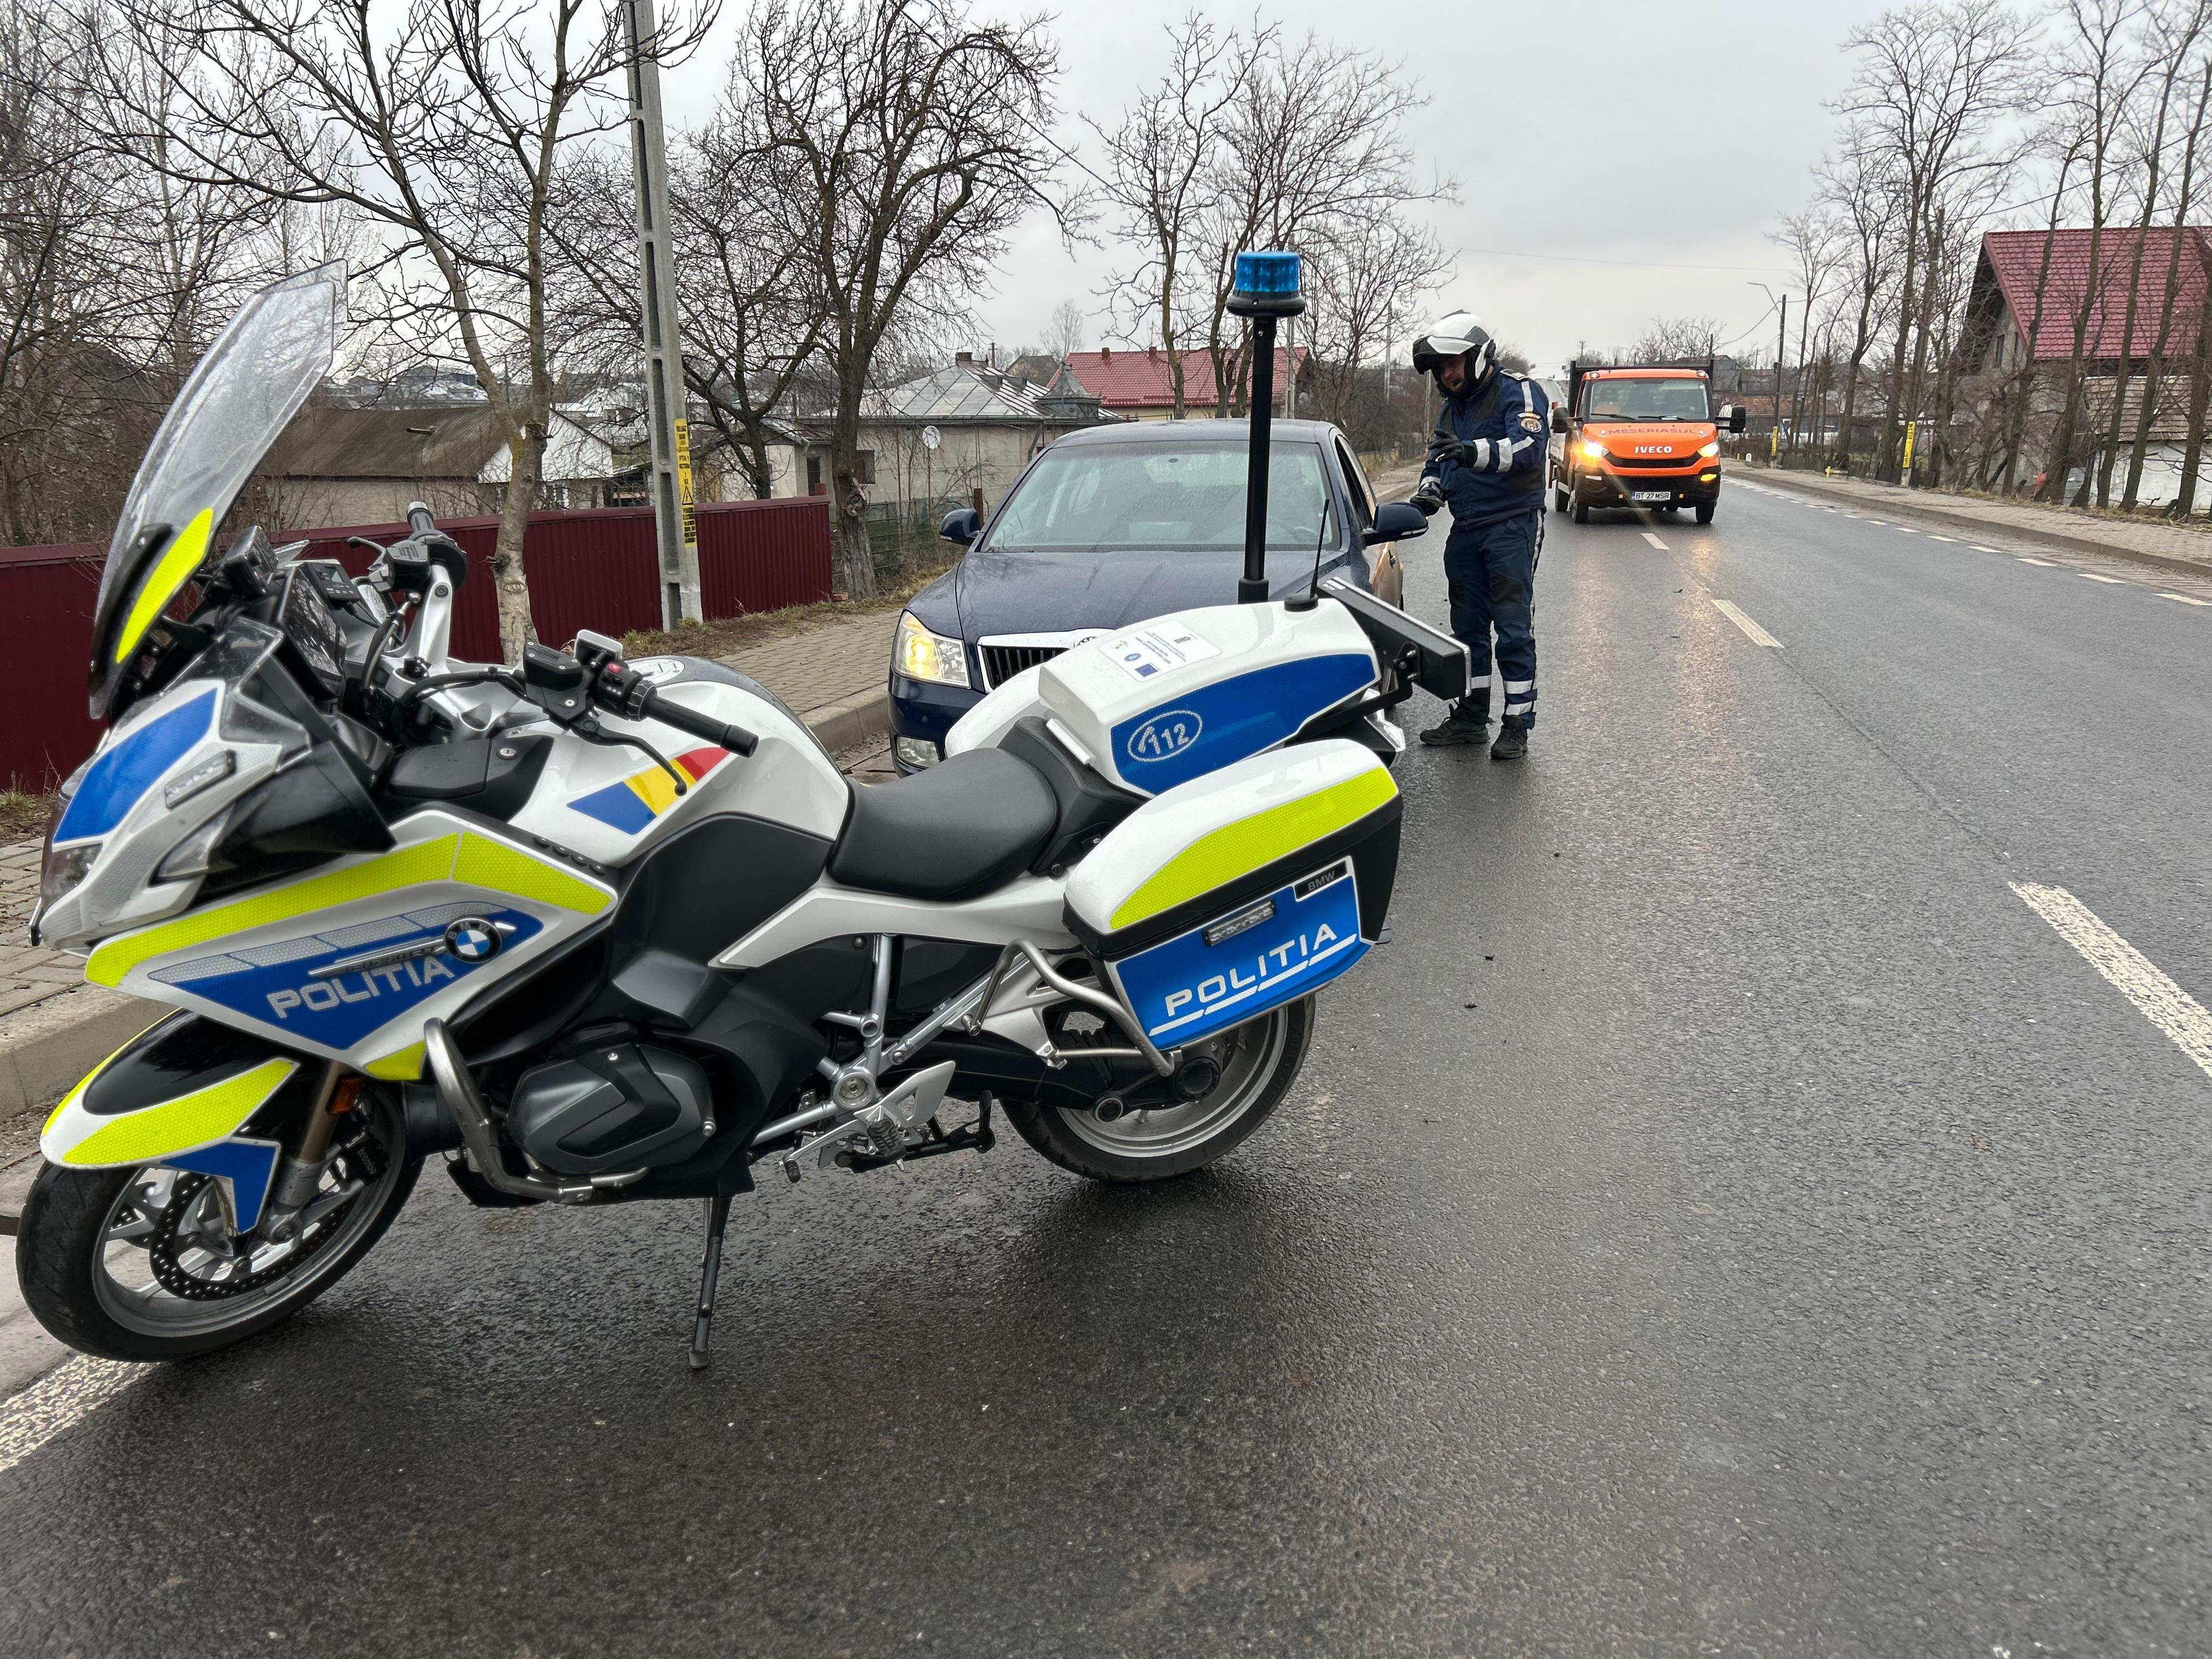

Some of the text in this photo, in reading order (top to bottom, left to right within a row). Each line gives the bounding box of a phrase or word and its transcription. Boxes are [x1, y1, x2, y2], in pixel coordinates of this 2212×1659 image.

[1634, 445, 1672, 454] IVECO
[1148, 723, 1189, 754] 112
[1307, 870, 1335, 891] BMW
[448, 922, 490, 940] BMW
[1164, 923, 1338, 1017] POLITIA
[266, 956, 456, 1019] POLITIA
[357, 1146, 377, 1175] brembo
